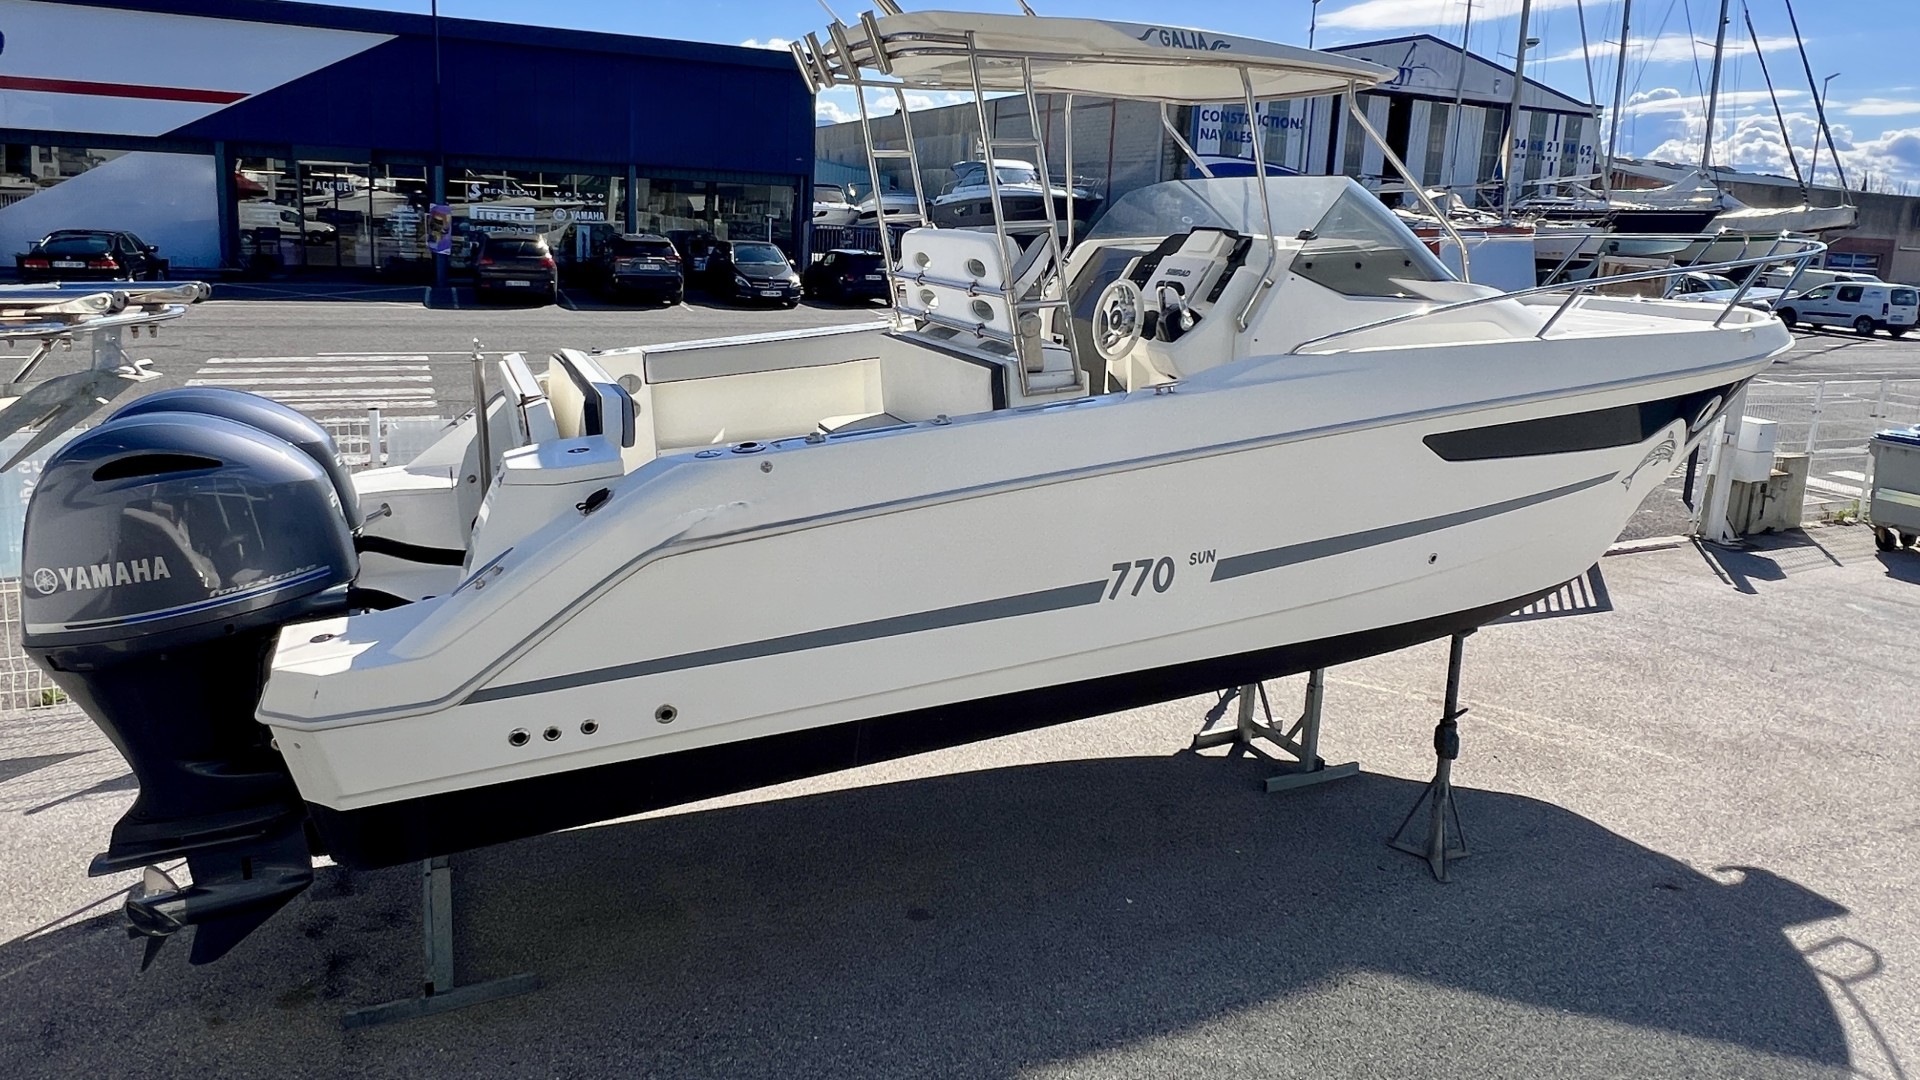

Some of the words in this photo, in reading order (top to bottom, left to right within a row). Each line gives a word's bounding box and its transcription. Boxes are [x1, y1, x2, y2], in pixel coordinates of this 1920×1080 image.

[1159, 30, 1208, 50] GALIA
[1546, 141, 1559, 152] 21
[1580, 144, 1592, 156] 62
[553, 191, 605, 199] VOLVO
[469, 205, 536, 221] PIRELLI
[570, 210, 605, 221] YAMAHA
[58, 556, 171, 592] YAMAHA
[1108, 556, 1175, 600] 770
[1189, 549, 1216, 566] SUN
